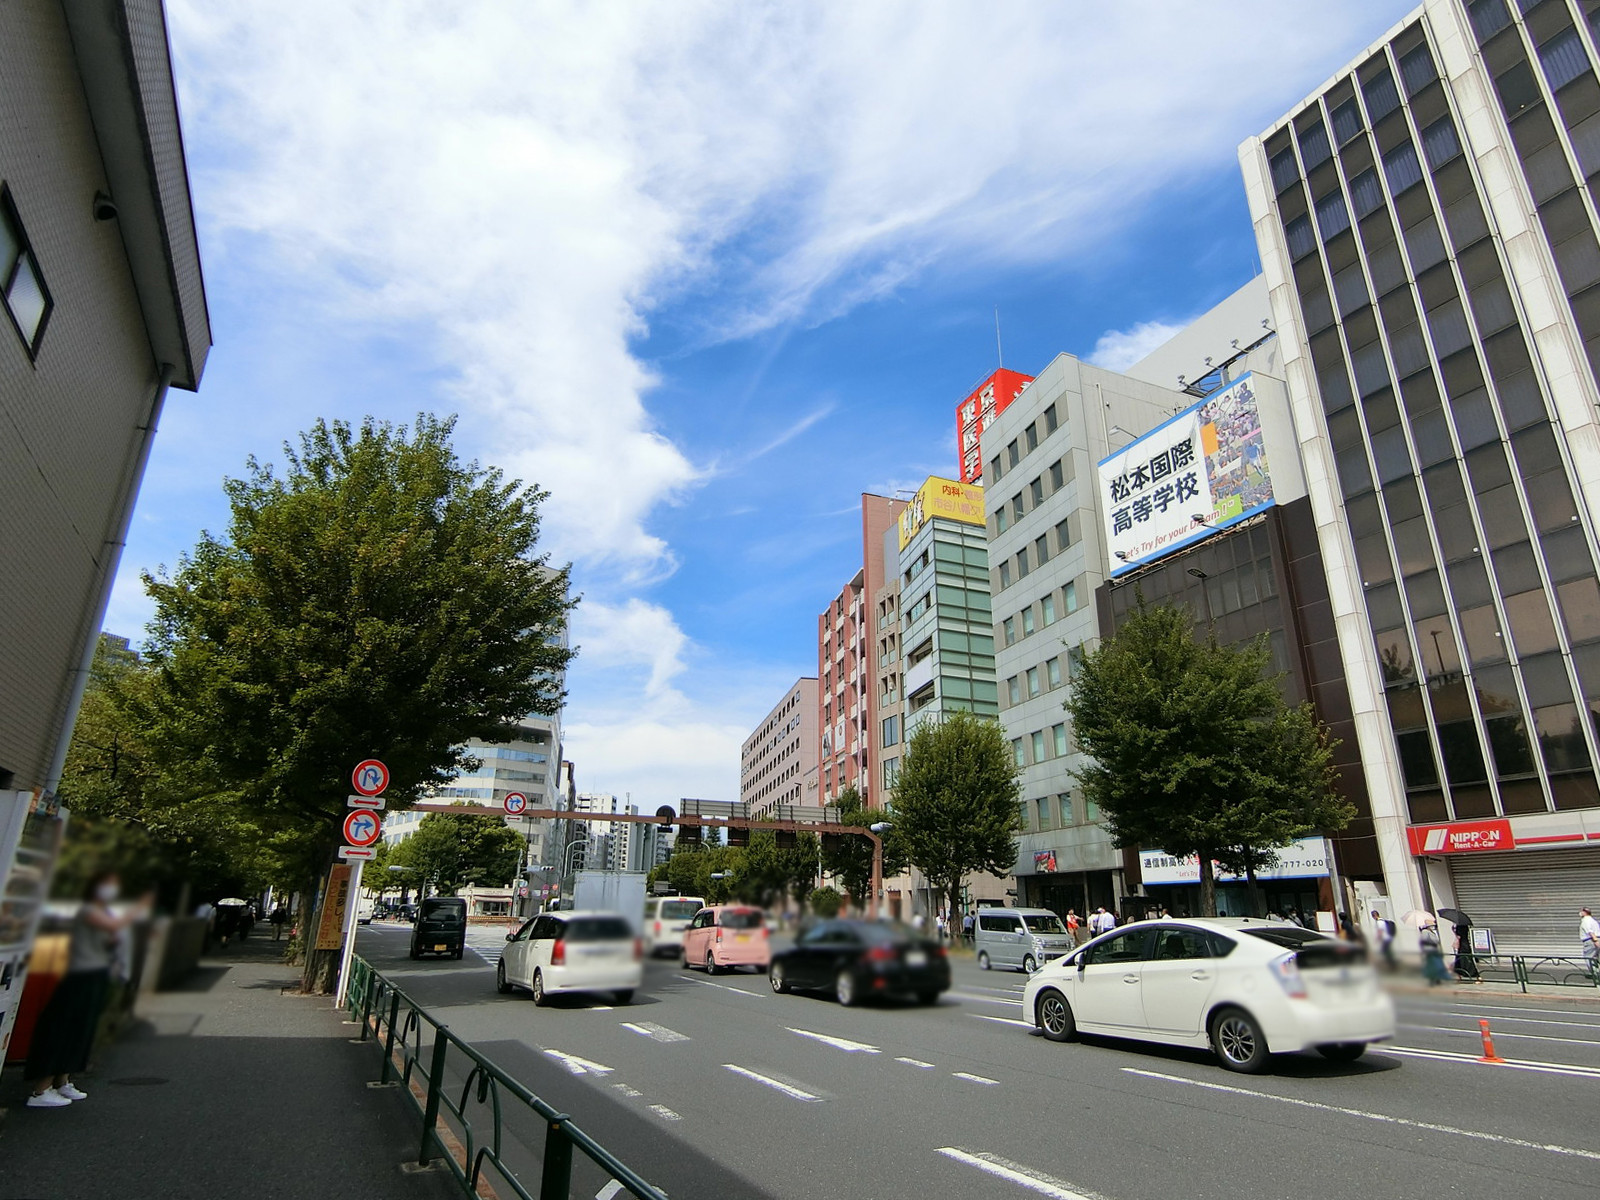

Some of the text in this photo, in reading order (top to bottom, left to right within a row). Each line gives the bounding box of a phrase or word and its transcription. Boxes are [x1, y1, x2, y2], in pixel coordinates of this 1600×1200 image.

[1109, 438, 1195, 504] 松本国際
[1111, 471, 1200, 537] 高等学校
[1141, 541, 1153, 552] Try
[1154, 534, 1167, 548] for
[1169, 525, 1188, 542] your
[1450, 829, 1500, 843] NIPPON
